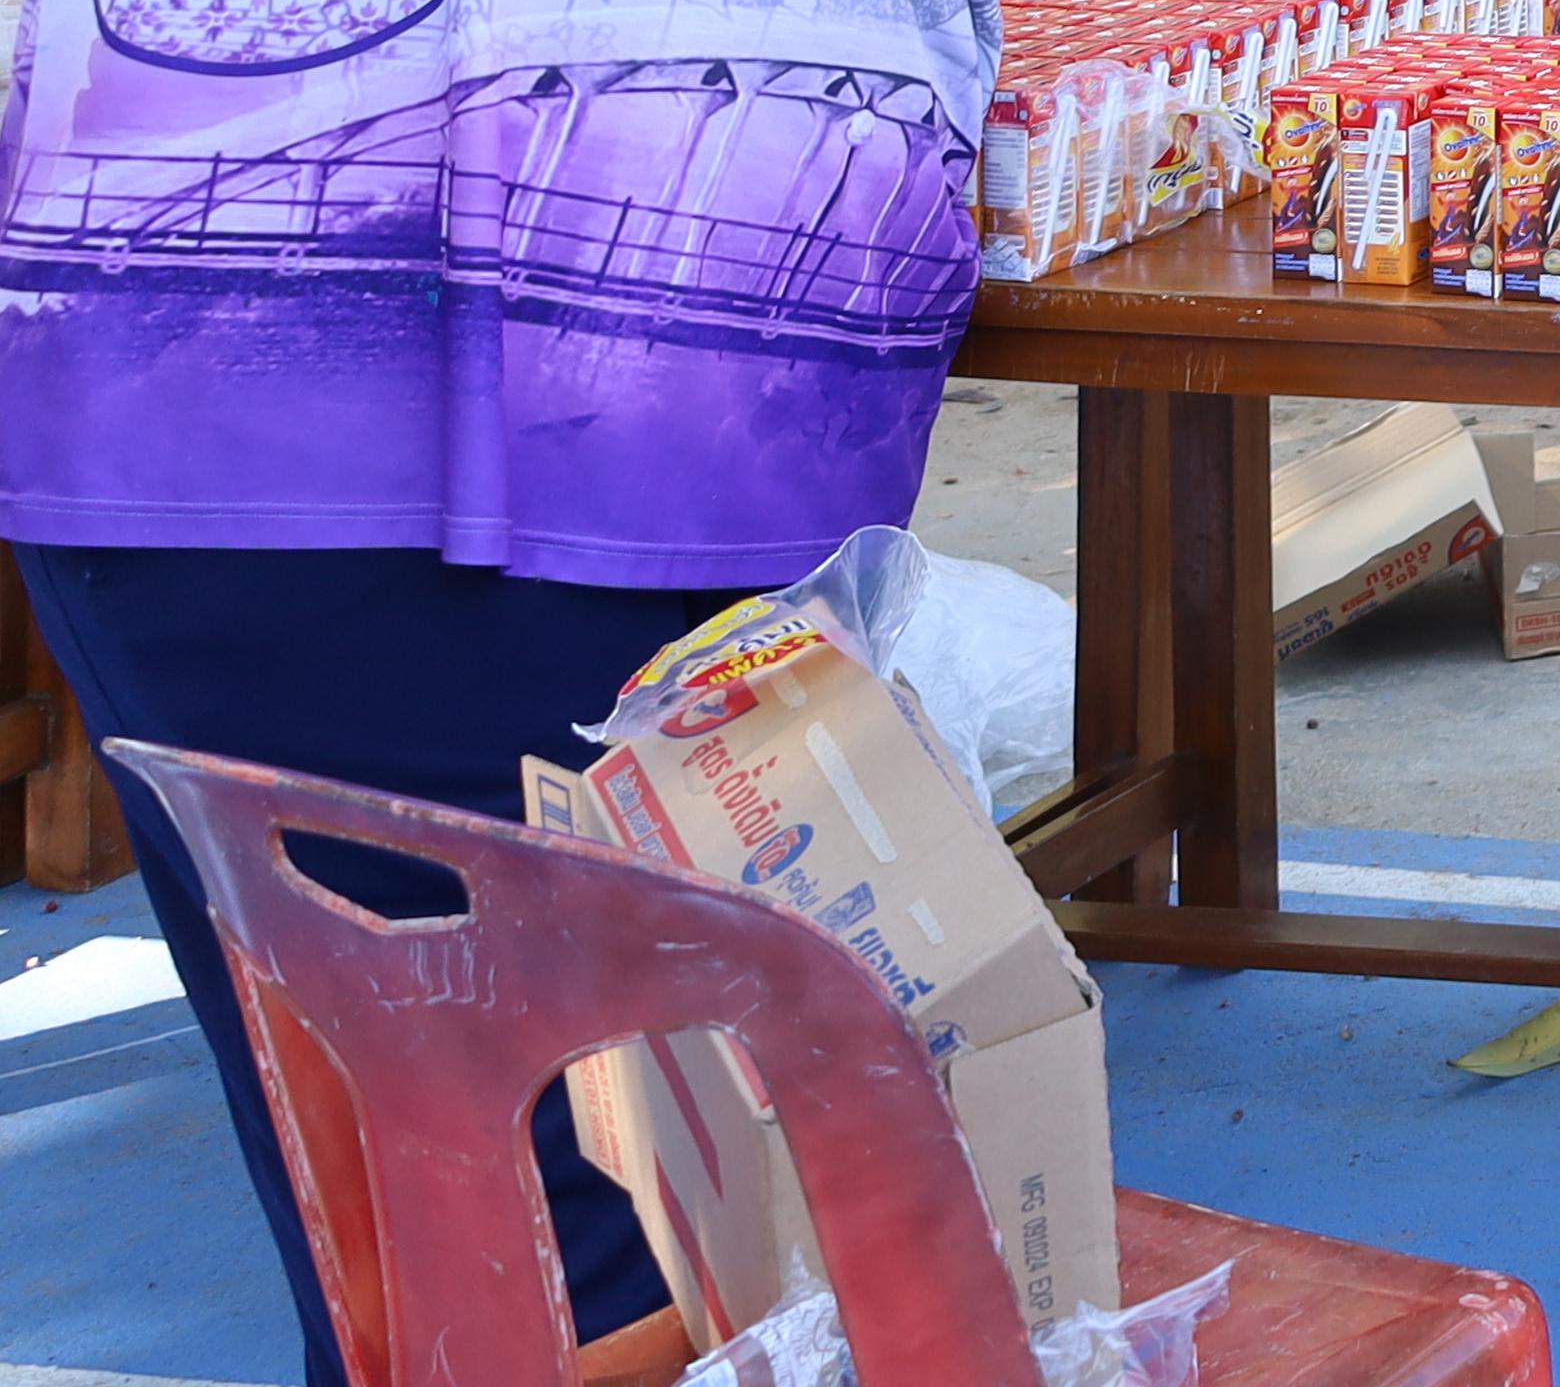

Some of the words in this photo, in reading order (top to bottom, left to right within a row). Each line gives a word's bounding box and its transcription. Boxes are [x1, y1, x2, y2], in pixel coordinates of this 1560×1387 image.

[1314, 100, 1328, 112] 10
[1473, 115, 1486, 126] 10
[1545, 119, 1558, 131] 10
[1285, 121, 1325, 139] Ovaltine
[1444, 135, 1483, 152] Ovaltine
[1517, 139, 1554, 157] Ovaltine
[682, 735, 734, 782] สูตร
[713, 754, 782, 850] ดั้งเดิม
[1019, 1172, 1046, 1213] MFG
[1028, 1274, 1054, 1312] EXP
